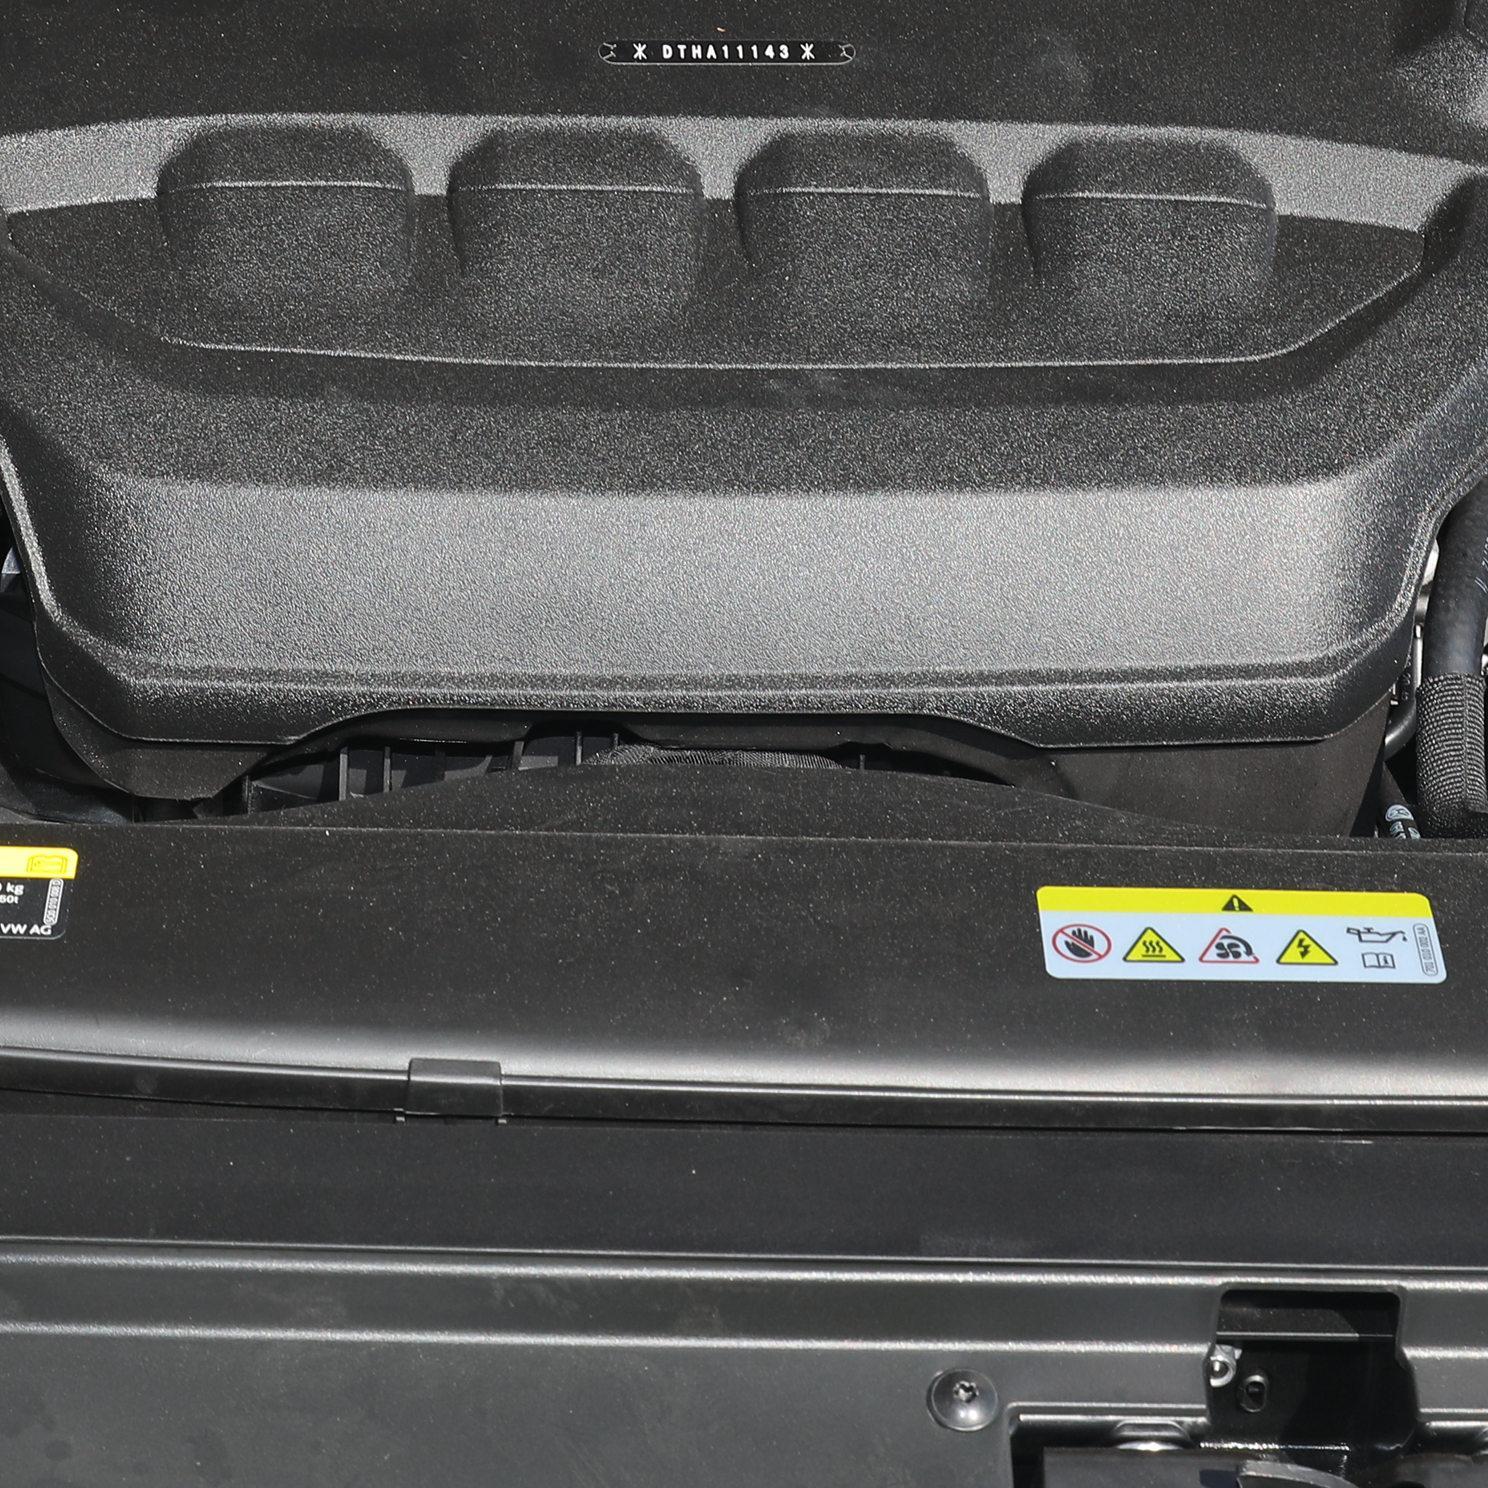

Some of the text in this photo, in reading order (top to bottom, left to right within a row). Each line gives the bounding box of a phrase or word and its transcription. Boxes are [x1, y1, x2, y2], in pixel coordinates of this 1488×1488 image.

[662, 44, 789, 60] DTHA11143
[5, 881, 24, 895] kg
[0, 923, 52, 935] VW AG
